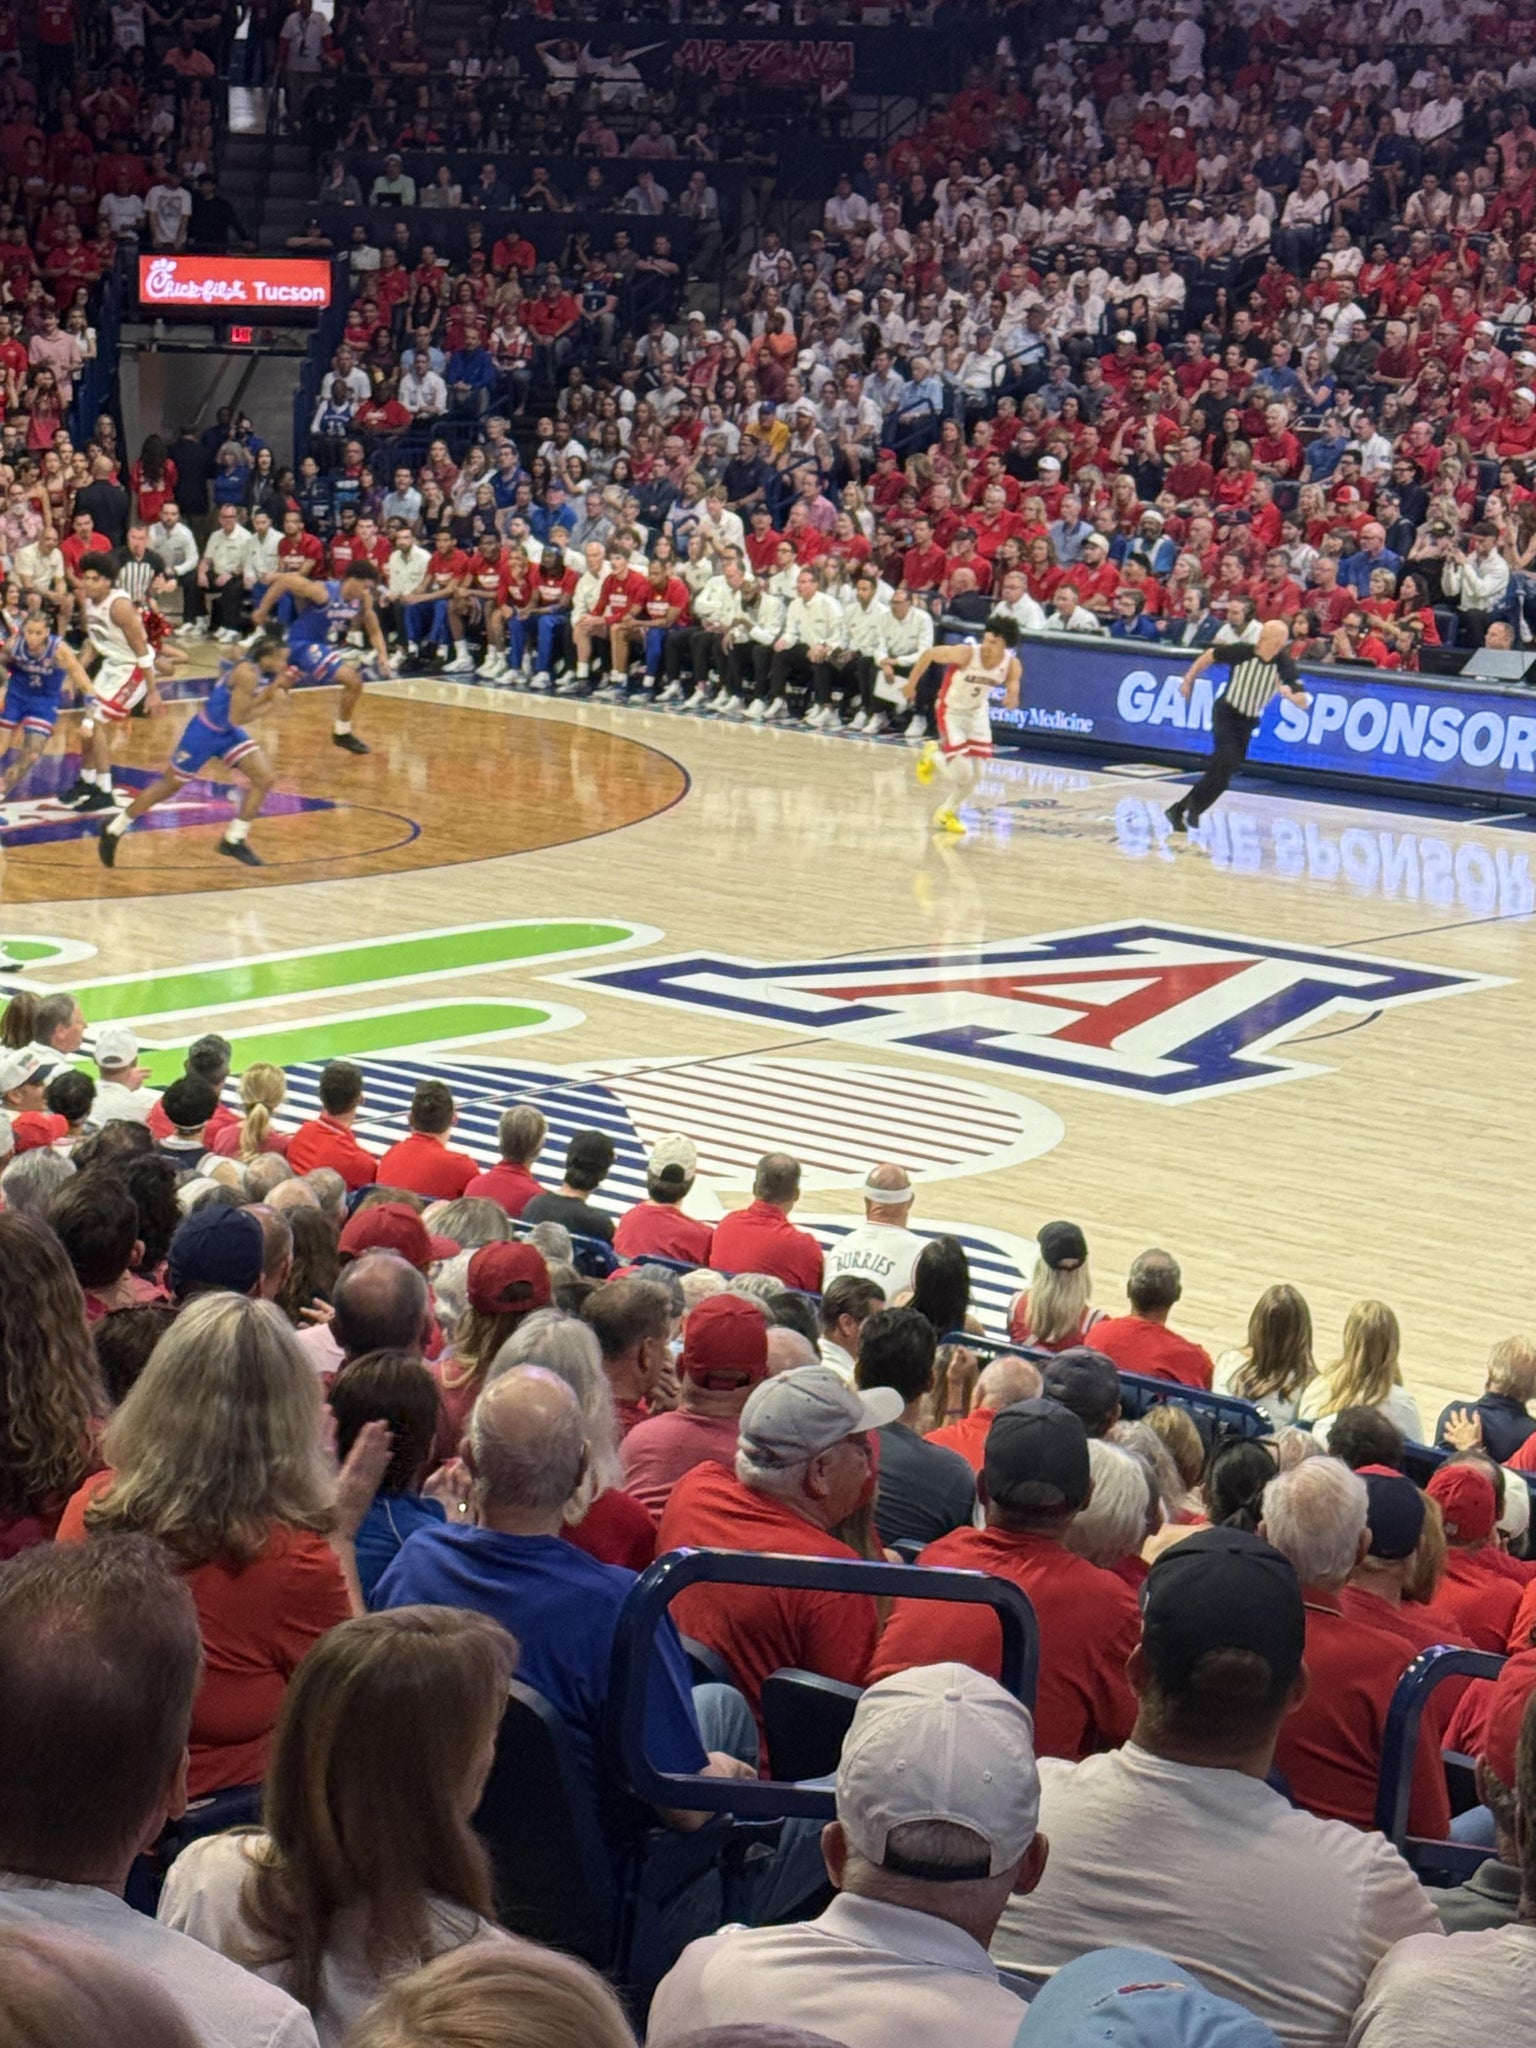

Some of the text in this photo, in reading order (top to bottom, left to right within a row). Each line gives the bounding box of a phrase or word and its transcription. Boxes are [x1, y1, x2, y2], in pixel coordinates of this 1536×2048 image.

[252, 281, 326, 302] Tucson
[1029, 708, 1094, 733] Medicine
[1116, 670, 1536, 773] GAM SPONSOR
